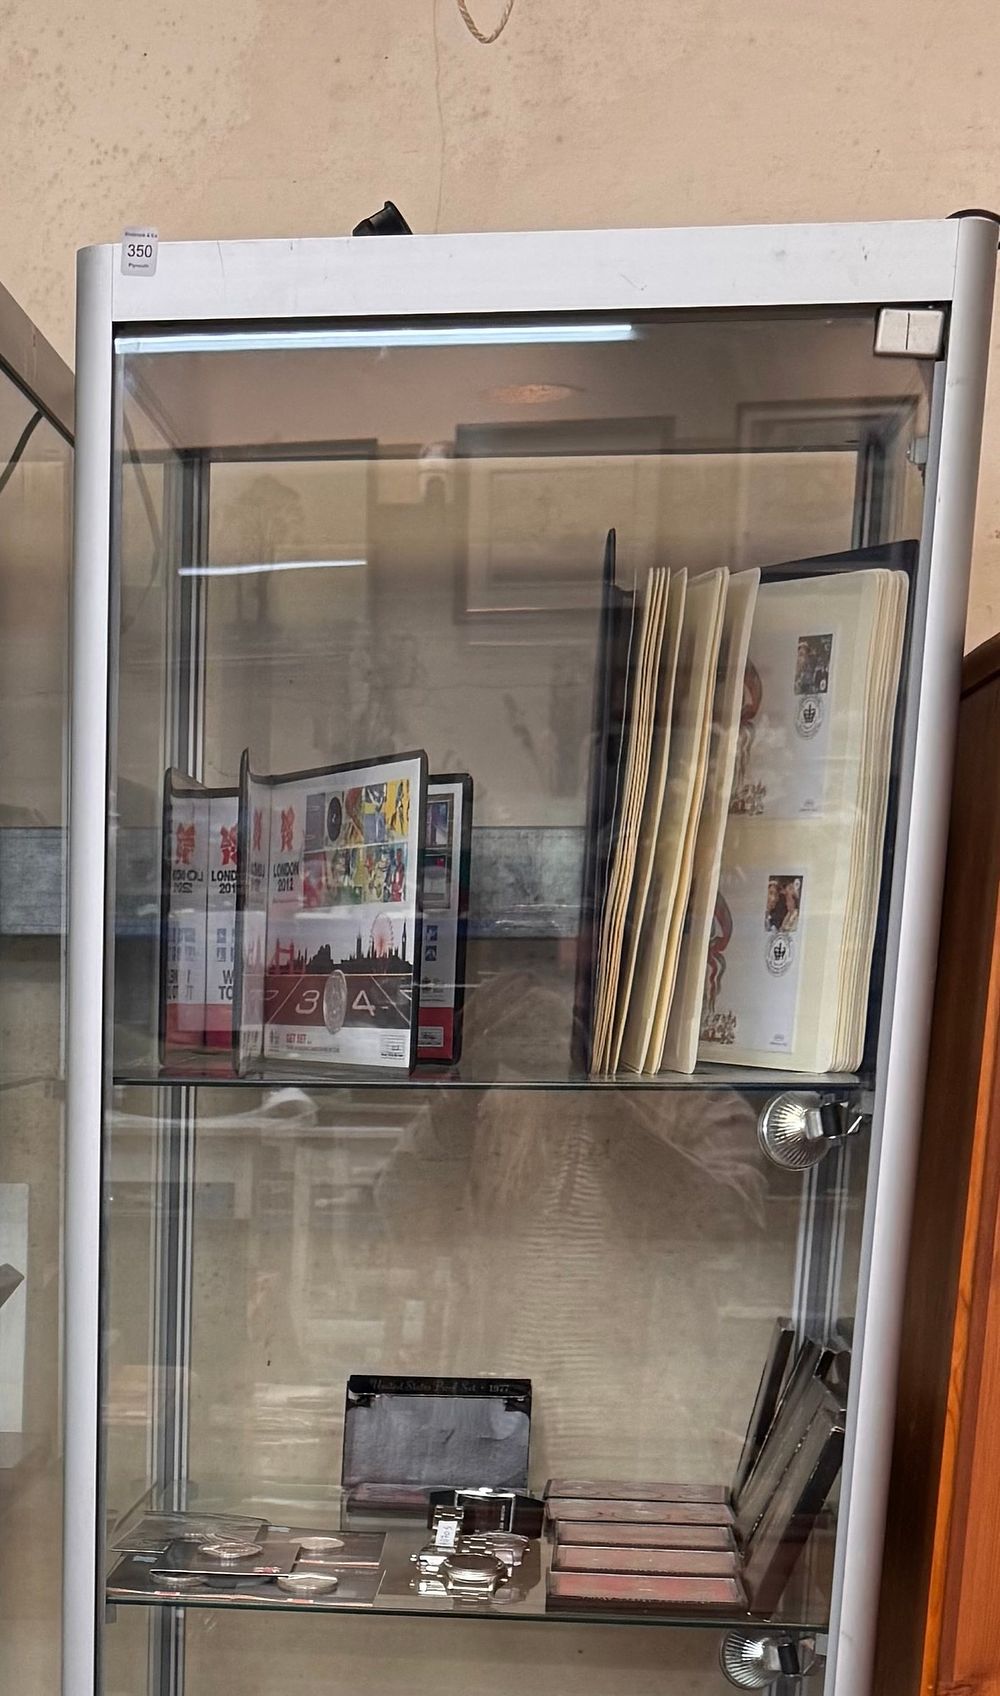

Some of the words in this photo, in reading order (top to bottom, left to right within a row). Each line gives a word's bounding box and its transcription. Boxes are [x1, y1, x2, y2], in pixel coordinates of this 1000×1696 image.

[127, 244, 153, 258] 350
[211, 870, 237, 881] LOND
[273, 861, 300, 878] LONDON
[219, 882, 236, 894] 201
[277, 878, 294, 892] 2012
[295, 990, 320, 1015] 3
[352, 990, 376, 1016] 4
